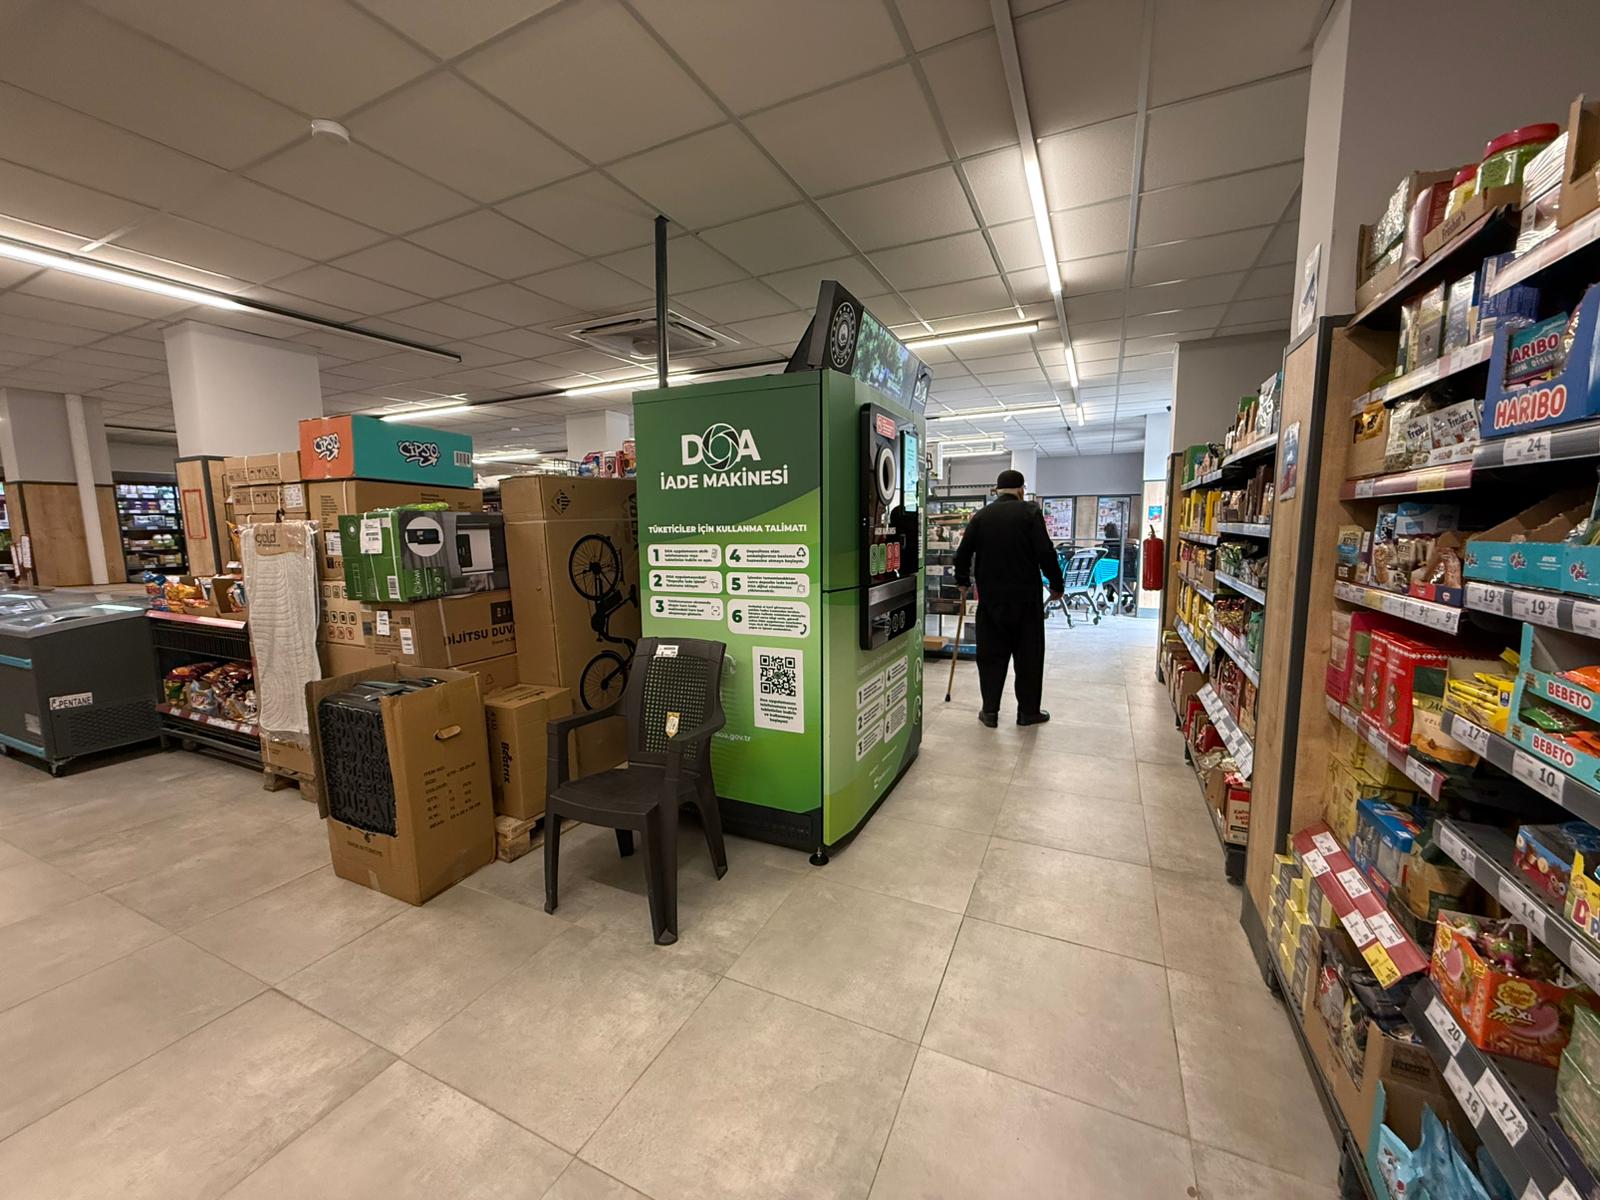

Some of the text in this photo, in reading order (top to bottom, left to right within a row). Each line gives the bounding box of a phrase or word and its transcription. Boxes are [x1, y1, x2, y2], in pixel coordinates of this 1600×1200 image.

[1510, 332, 1560, 364] ARIBO
[1495, 385, 1566, 429] HARIBO
[1527, 437, 1542, 453] 24
[660, 465, 788, 490] İADE MAKİNESİ
[648, 522, 807, 535] TÜKETİCİLER İÇİN KULLANMA TALİMATI
[653, 549, 659, 561] 1
[729, 549, 741, 562] 4
[653, 574, 662, 586] 2
[731, 577, 741, 591] 5
[1484, 589, 1495, 603] 19
[655, 600, 664, 612] 3
[1531, 600, 1545, 615] 19
[732, 609, 742, 623] 6
[1547, 681, 1592, 711] BEBETO
[1427, 702, 1443, 712] JAC
[1468, 726, 1480, 741] 17
[1532, 735, 1575, 767] BEBETO
[1539, 767, 1555, 787] 10
[1460, 848, 1467, 861] 9
[1521, 902, 1536, 923] 14
[1447, 1022, 1461, 1042] 20
[1465, 1091, 1478, 1114] 16
[1500, 1101, 1517, 1122] 17
